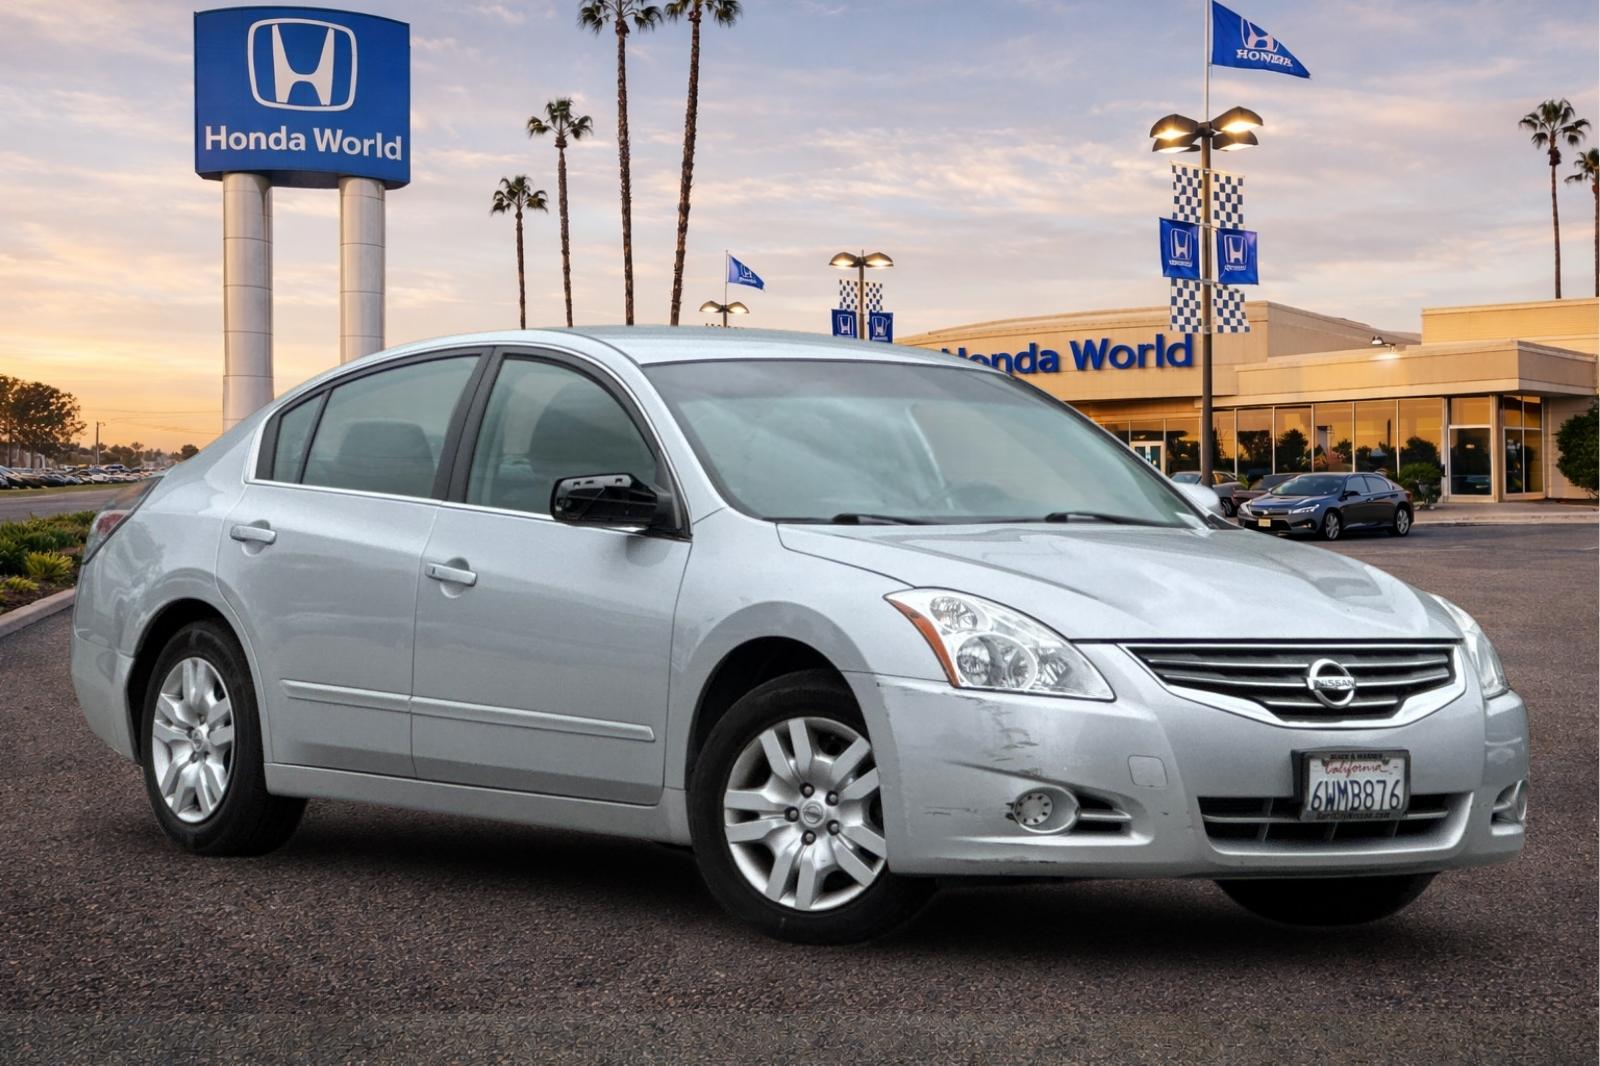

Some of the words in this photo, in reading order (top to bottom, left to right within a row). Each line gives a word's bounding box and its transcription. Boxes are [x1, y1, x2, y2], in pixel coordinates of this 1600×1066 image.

[205, 125, 305, 151] Honda
[313, 127, 402, 161] World
[941, 342, 1060, 375] nda
[1069, 333, 1194, 371] World
[1325, 760, 1388, 778] California
[1310, 779, 1401, 812] 6WMB876
